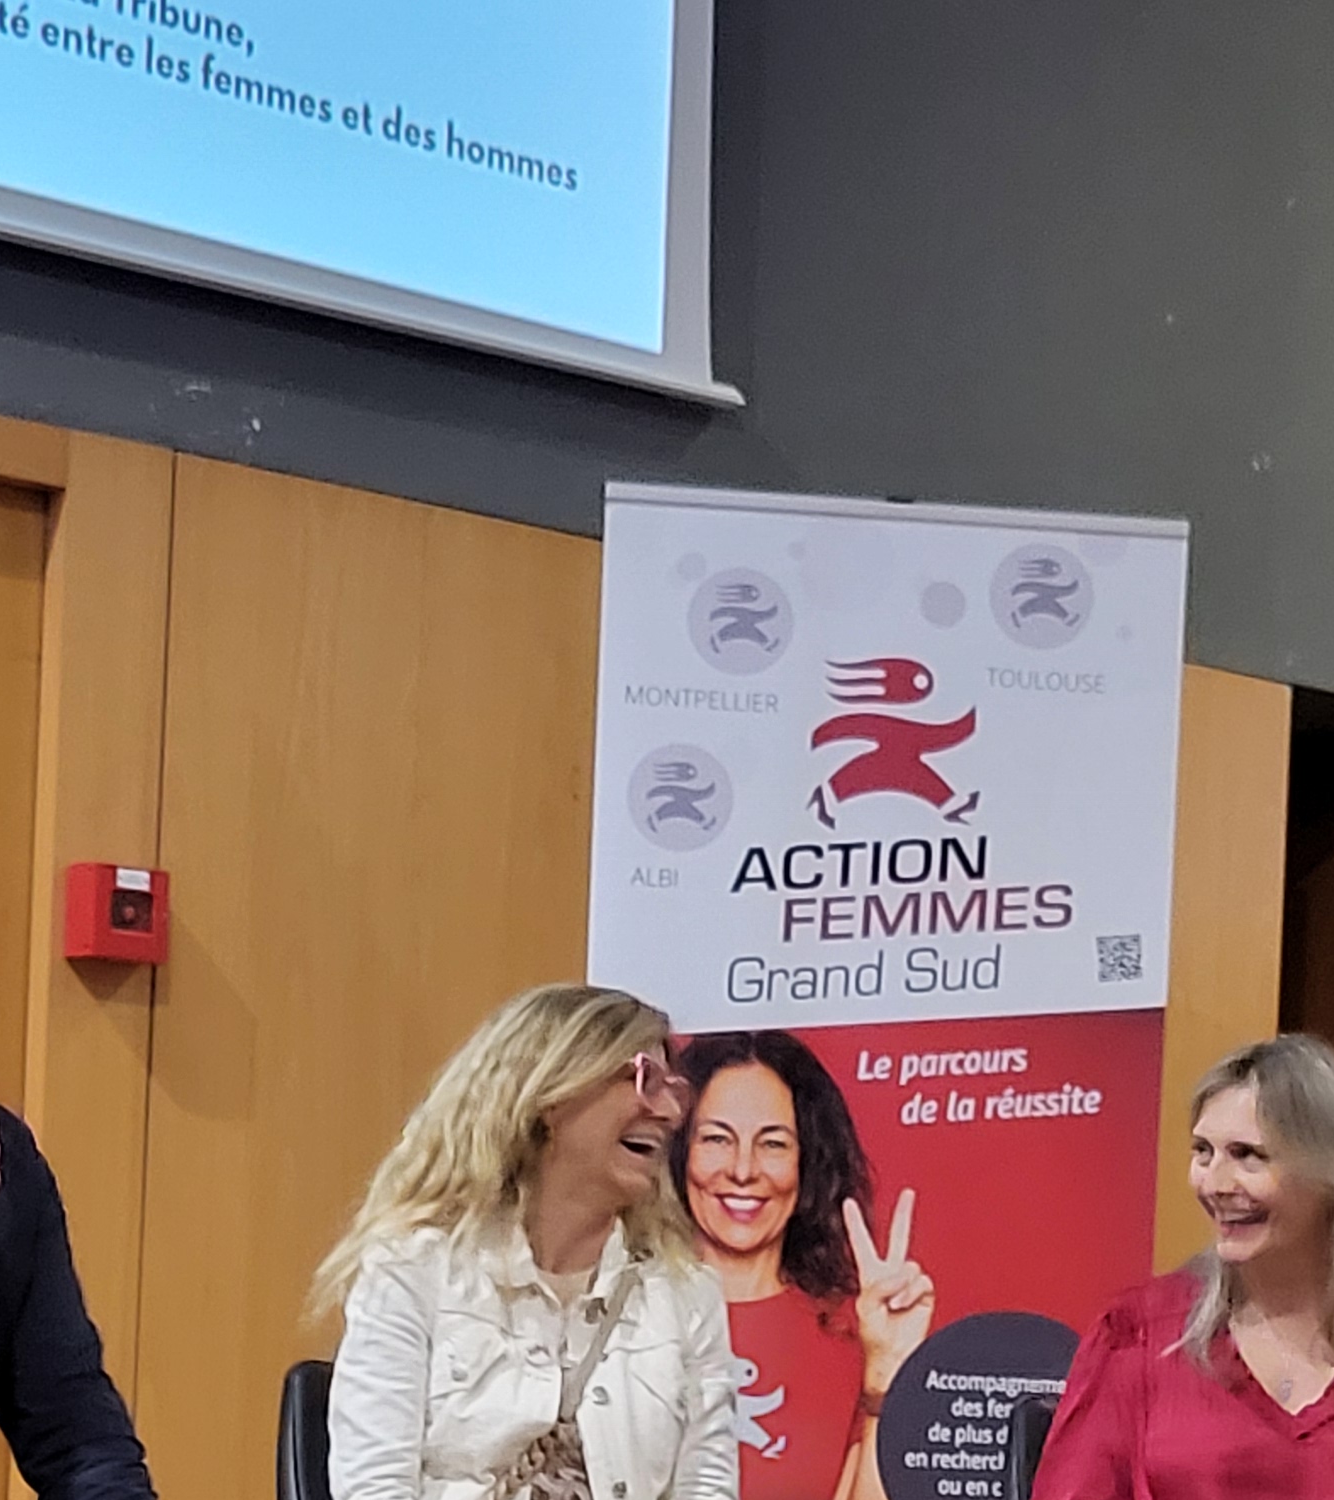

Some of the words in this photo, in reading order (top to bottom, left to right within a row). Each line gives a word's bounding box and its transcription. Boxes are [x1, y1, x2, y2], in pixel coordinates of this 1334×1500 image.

[40, 21, 136, 68] entre
[145, 34, 191, 84] les
[201, 52, 333, 124] femmes
[341, 102, 373, 136] et
[381, 103, 437, 152] des
[446, 119, 578, 191] hommes
[986, 666, 1107, 695] TOULOUSE
[623, 685, 780, 713] MONTPELLIER
[630, 867, 680, 888] ALBI
[730, 835, 988, 893] ACTION
[782, 884, 1073, 943] FEMMES
[727, 949, 884, 1003] Grand
[905, 942, 1002, 994] Sud
[856, 1050, 892, 1081] Le
[898, 1048, 1028, 1086] parcours
[900, 1091, 938, 1125] de
[946, 1090, 976, 1123] la
[984, 1081, 1102, 1120] réussite
[925, 1369, 1067, 1398] Accompagneme
[950, 1396, 984, 1418] des
[927, 1422, 952, 1443] de
[954, 1422, 993, 1448] plus
[995, 1424, 1009, 1445] d
[904, 1451, 928, 1469] en
[937, 1478, 962, 1495] ou
[965, 1480, 989, 1496] en
